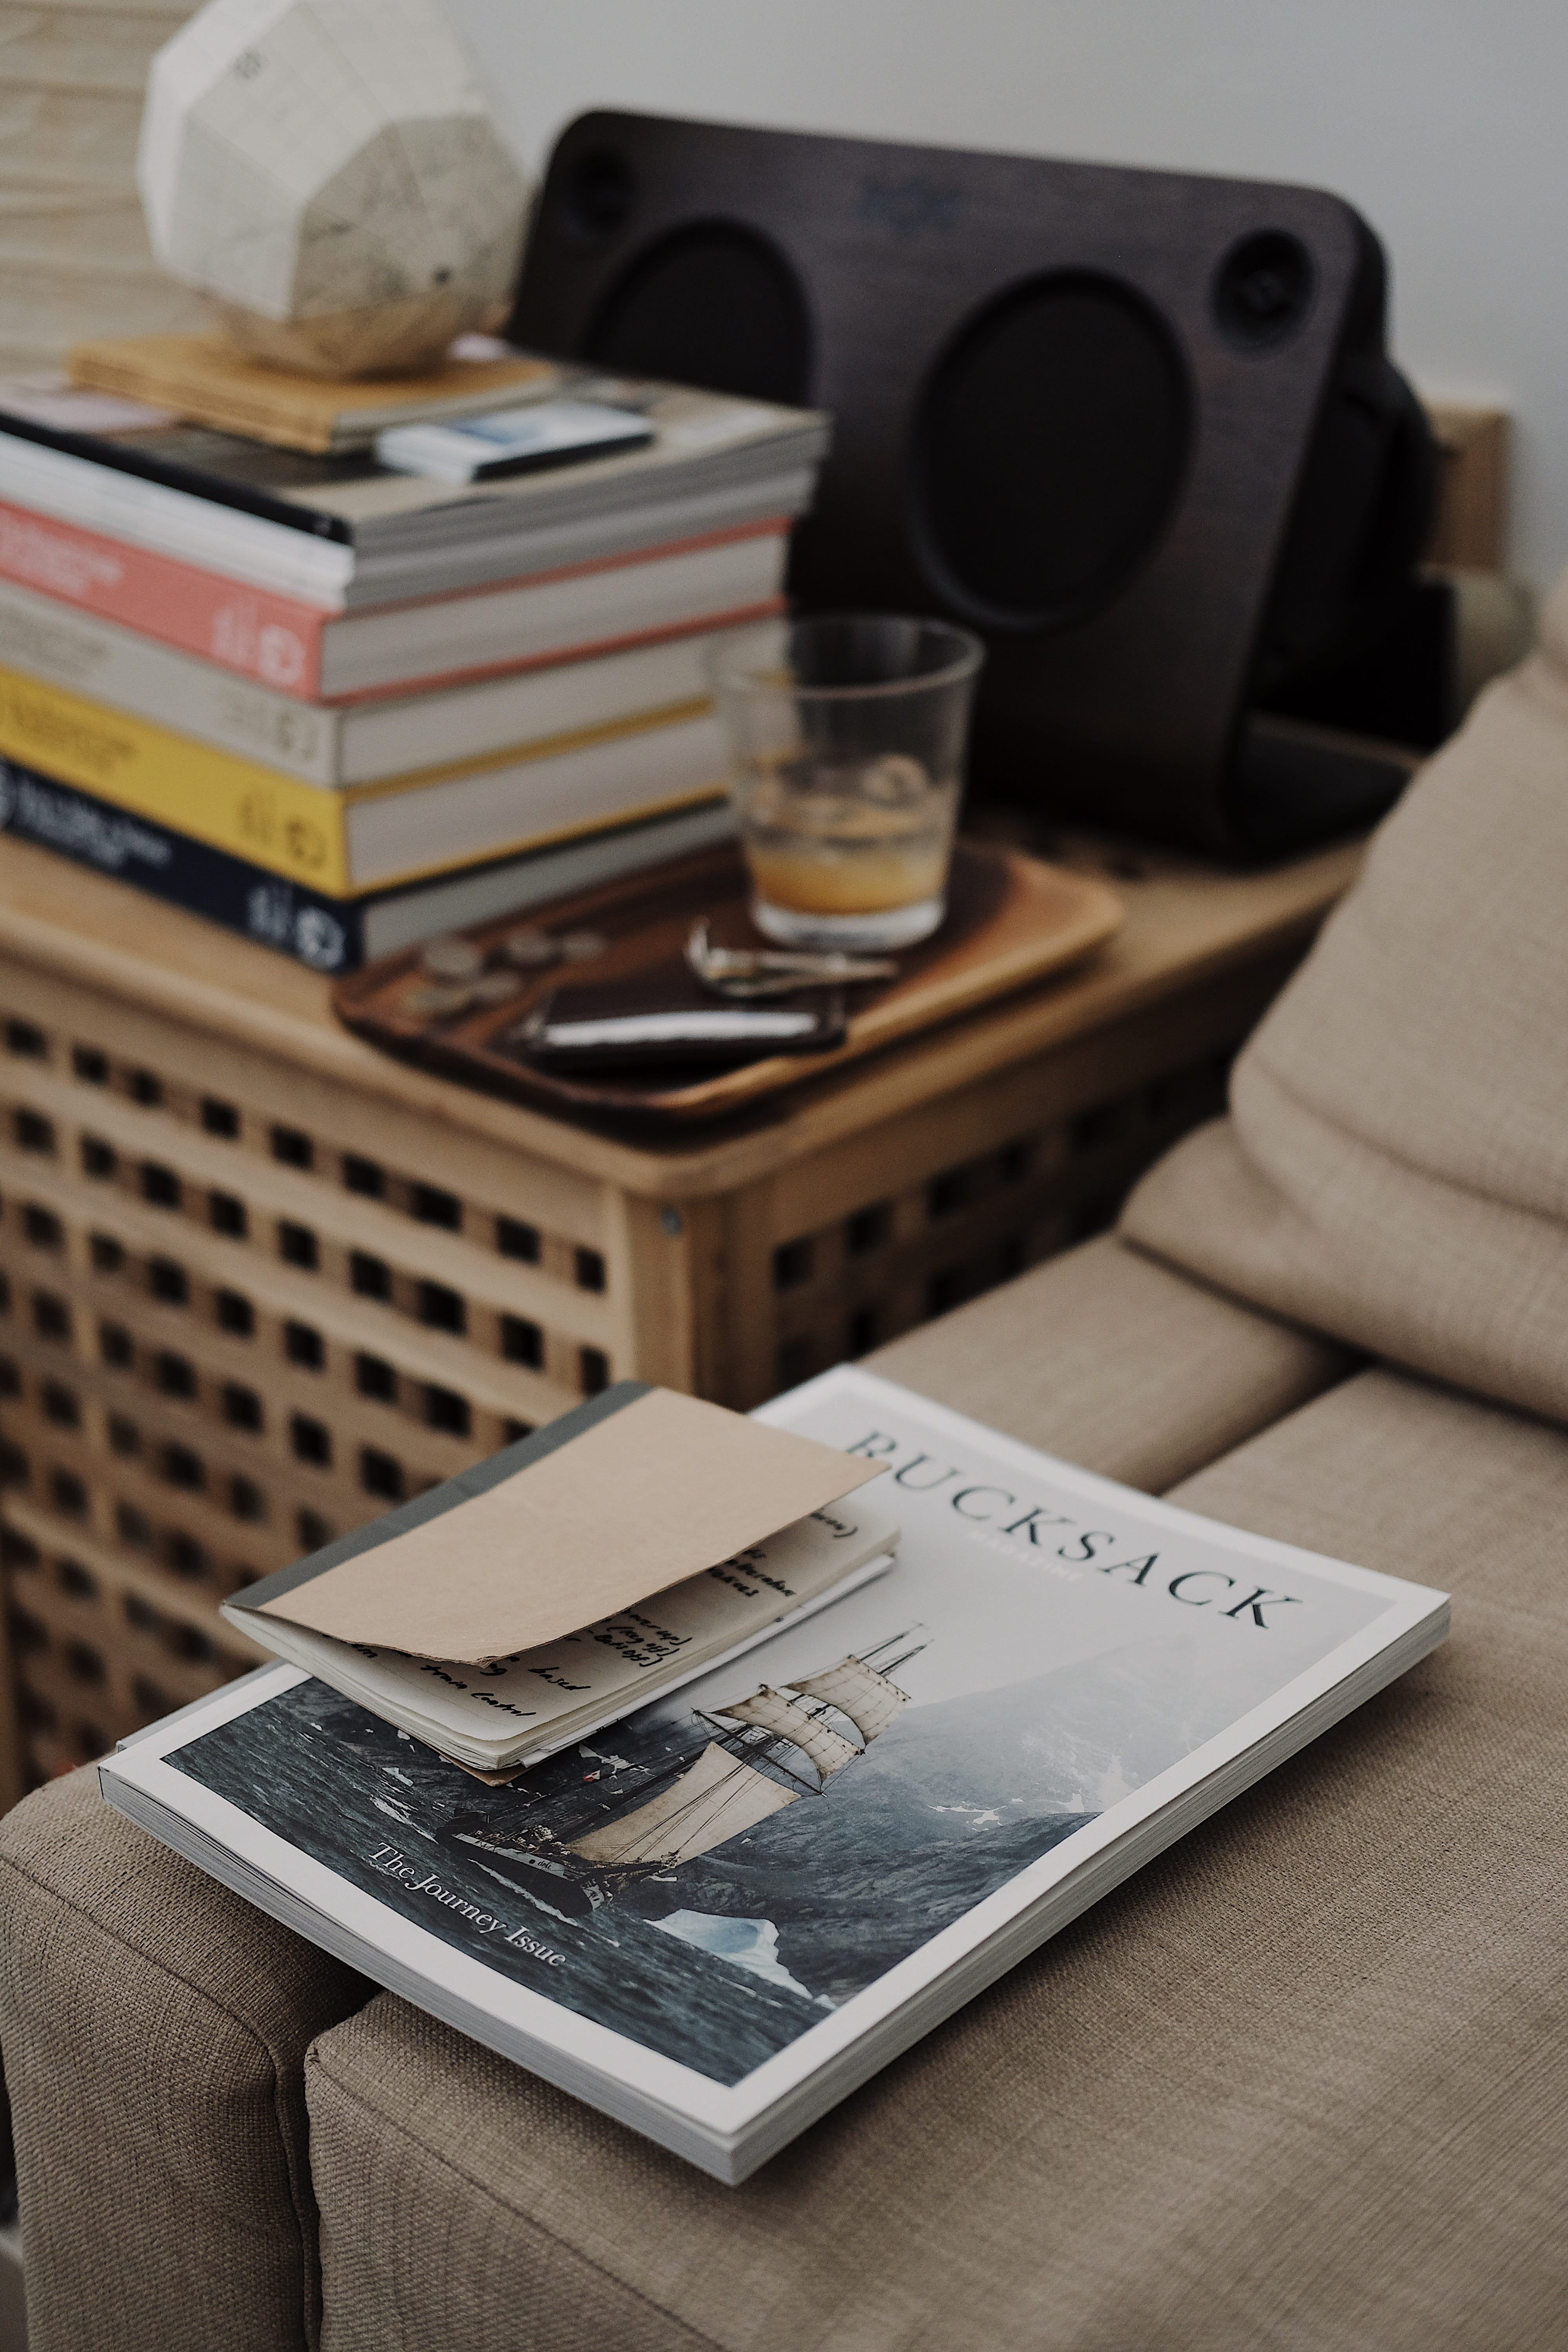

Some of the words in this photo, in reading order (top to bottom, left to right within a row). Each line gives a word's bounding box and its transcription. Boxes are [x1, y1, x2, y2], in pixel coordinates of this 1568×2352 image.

[846, 1429, 1302, 1629] RUCKSACK
[528, 1667, 591, 1691] based
[368, 1842, 415, 1879] The
[405, 1873, 506, 1934] Journey
[504, 1925, 567, 1967] Issue
